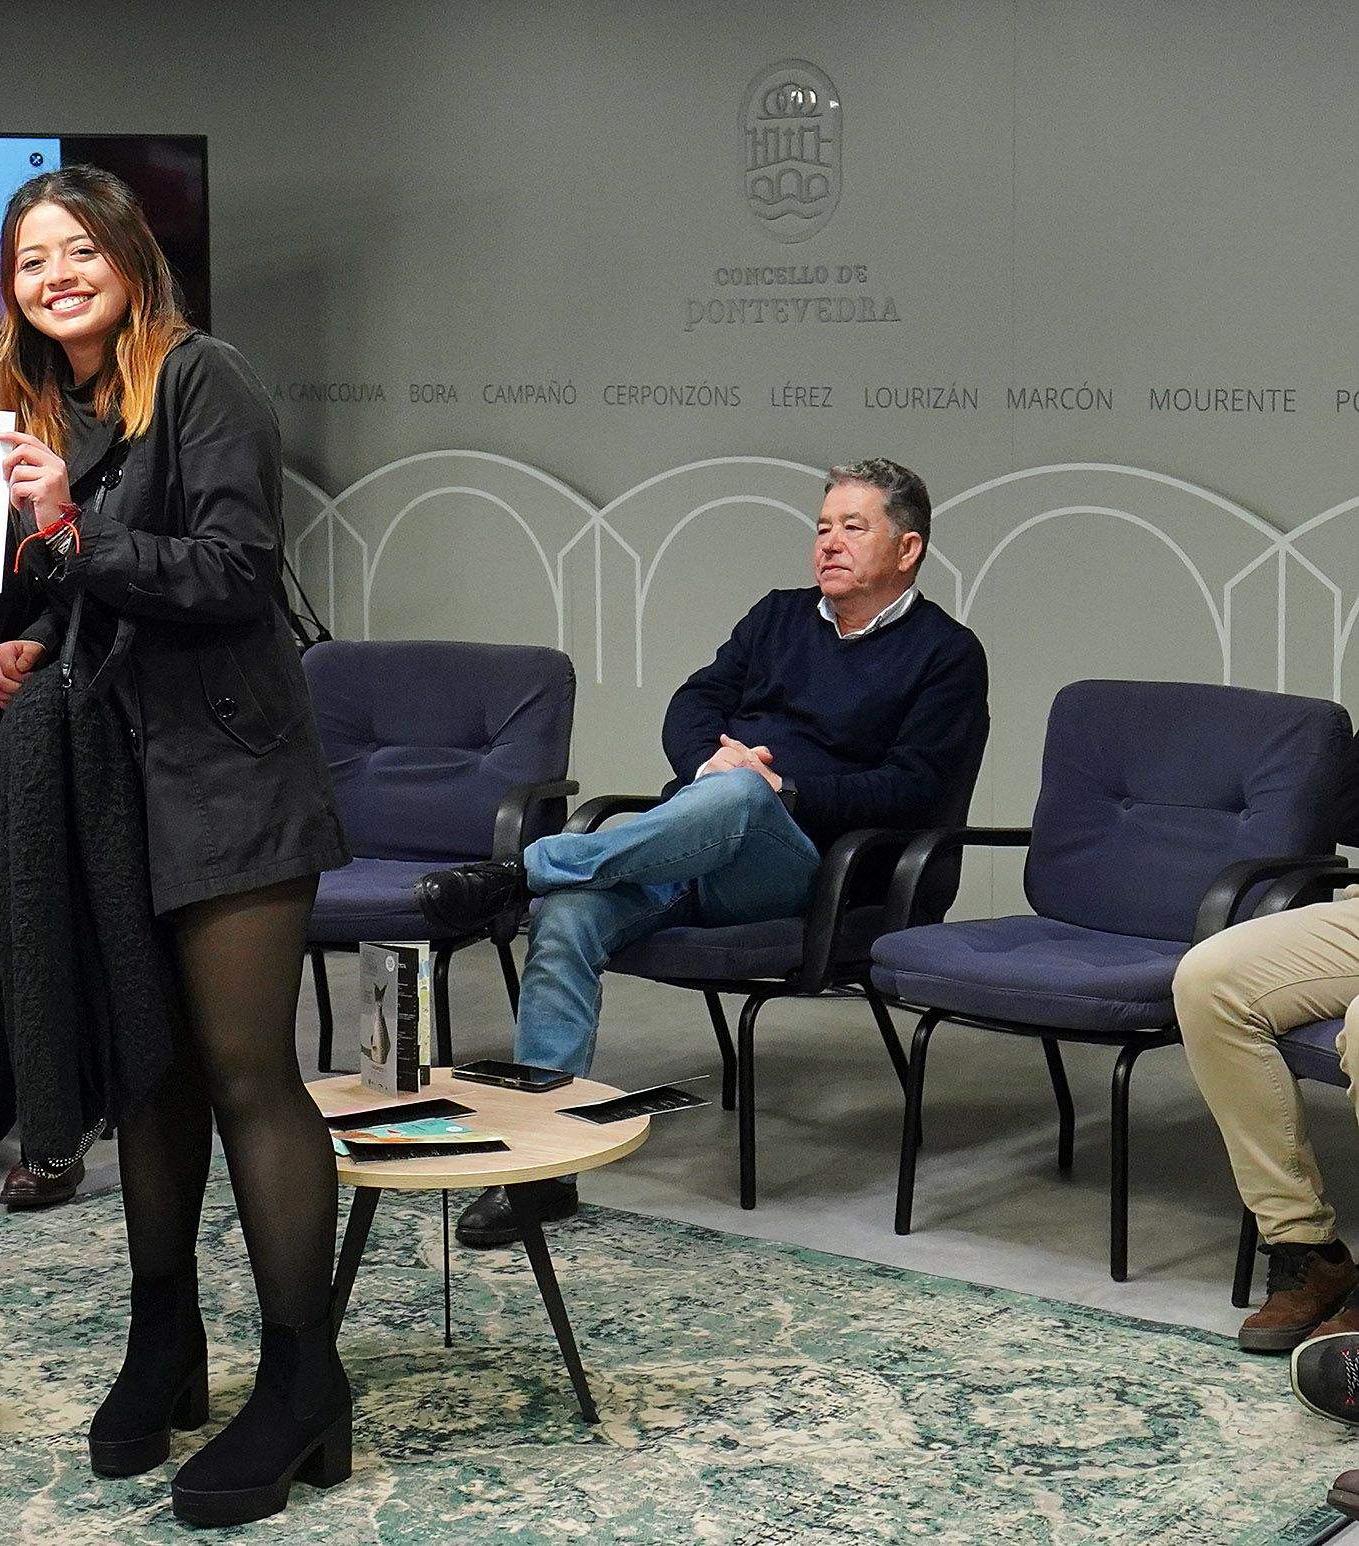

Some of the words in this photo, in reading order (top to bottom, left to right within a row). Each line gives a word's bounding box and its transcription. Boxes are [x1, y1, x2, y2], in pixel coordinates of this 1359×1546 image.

[715, 265, 829, 286] CONCELLO
[837, 264, 868, 284] DE
[683, 297, 902, 332] PONTEVEDRA
[409, 384, 458, 403] BORA
[482, 379, 577, 404] CAMPAÑÓ
[602, 380, 741, 407] CERPONZÓNS
[770, 381, 833, 408] LÉREZ
[864, 382, 979, 409] LOURIZÁN
[1006, 381, 1113, 411] MARCÓN
[1149, 388, 1297, 413] MOURENTE
